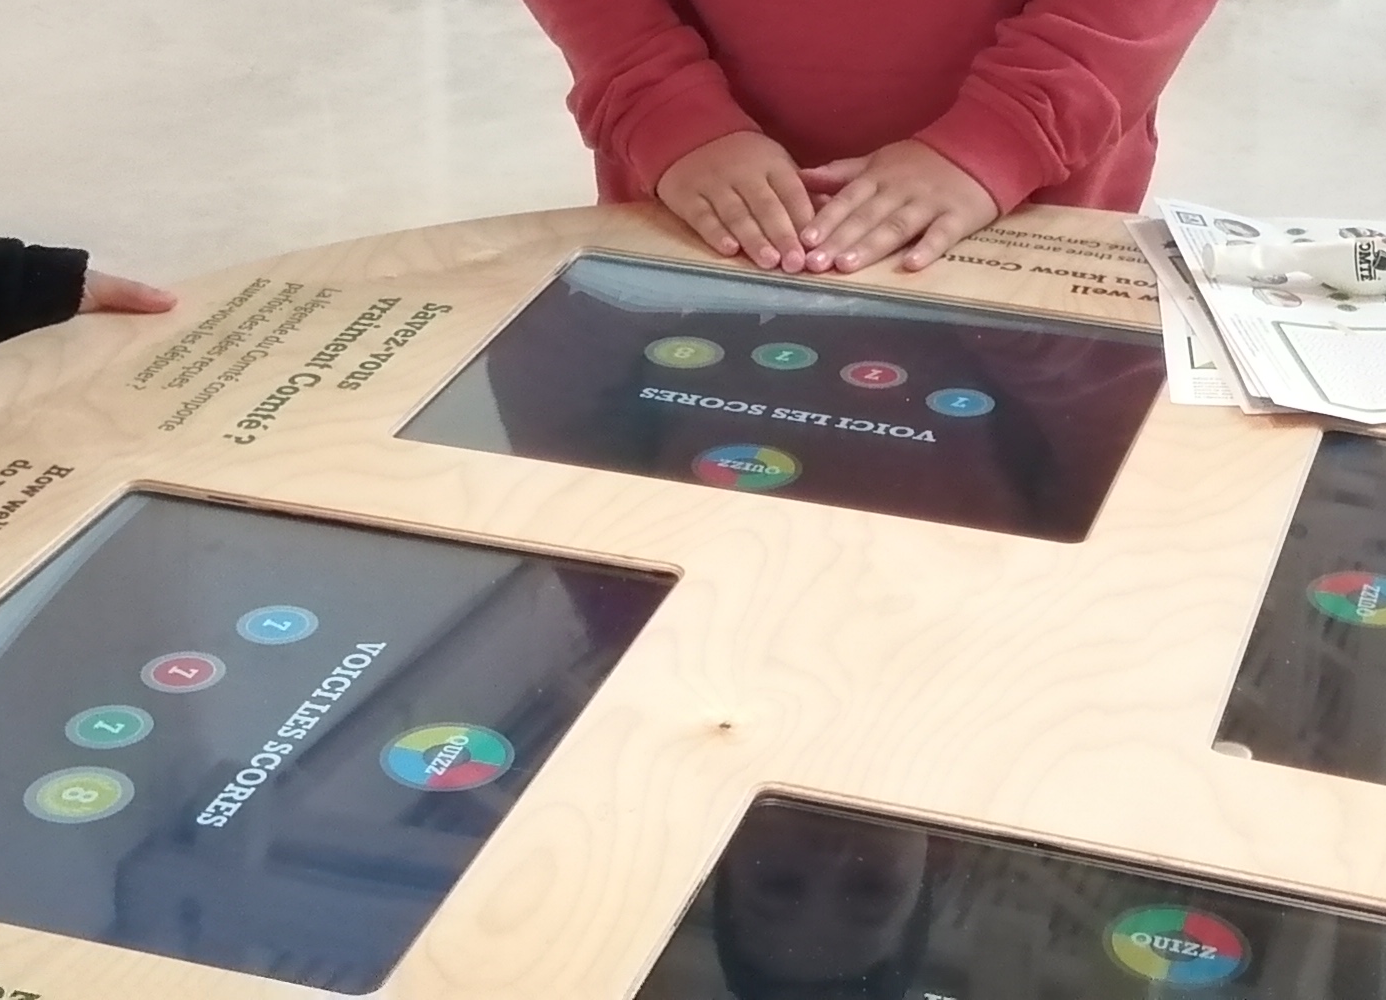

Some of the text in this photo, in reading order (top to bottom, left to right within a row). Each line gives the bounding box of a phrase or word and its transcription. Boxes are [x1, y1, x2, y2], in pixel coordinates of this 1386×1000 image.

[1034, 244, 1062, 253] are
[1066, 248, 1113, 261] there
[1357, 241, 1374, 282] OMTÉ
[940, 253, 1023, 272] Comt
[1029, 265, 1110, 284] know
[198, 278, 271, 329] saurez-vous
[258, 282, 304, 313] parfois
[1070, 284, 1131, 300] well
[238, 314, 270, 330] des
[304, 296, 402, 371] vraiment
[180, 331, 214, 344] les
[207, 331, 252, 356] idées
[338, 302, 453, 391] Savez-vous
[158, 288, 342, 431] La légende du Comté comporte
[673, 346, 696, 359] 8
[639, 387, 937, 443] VOICI LES SCORES
[0, 459, 33, 478] do
[717, 458, 781, 476] QUIZZ
[22, 464, 74, 499] How
[1356, 584, 1381, 618] QUIZZ
[196, 642, 387, 828] VOICI LES SCORES
[424, 734, 470, 777] QUIZZ
[61, 785, 100, 804] 8
[1130, 931, 1219, 960] QUIZZ
